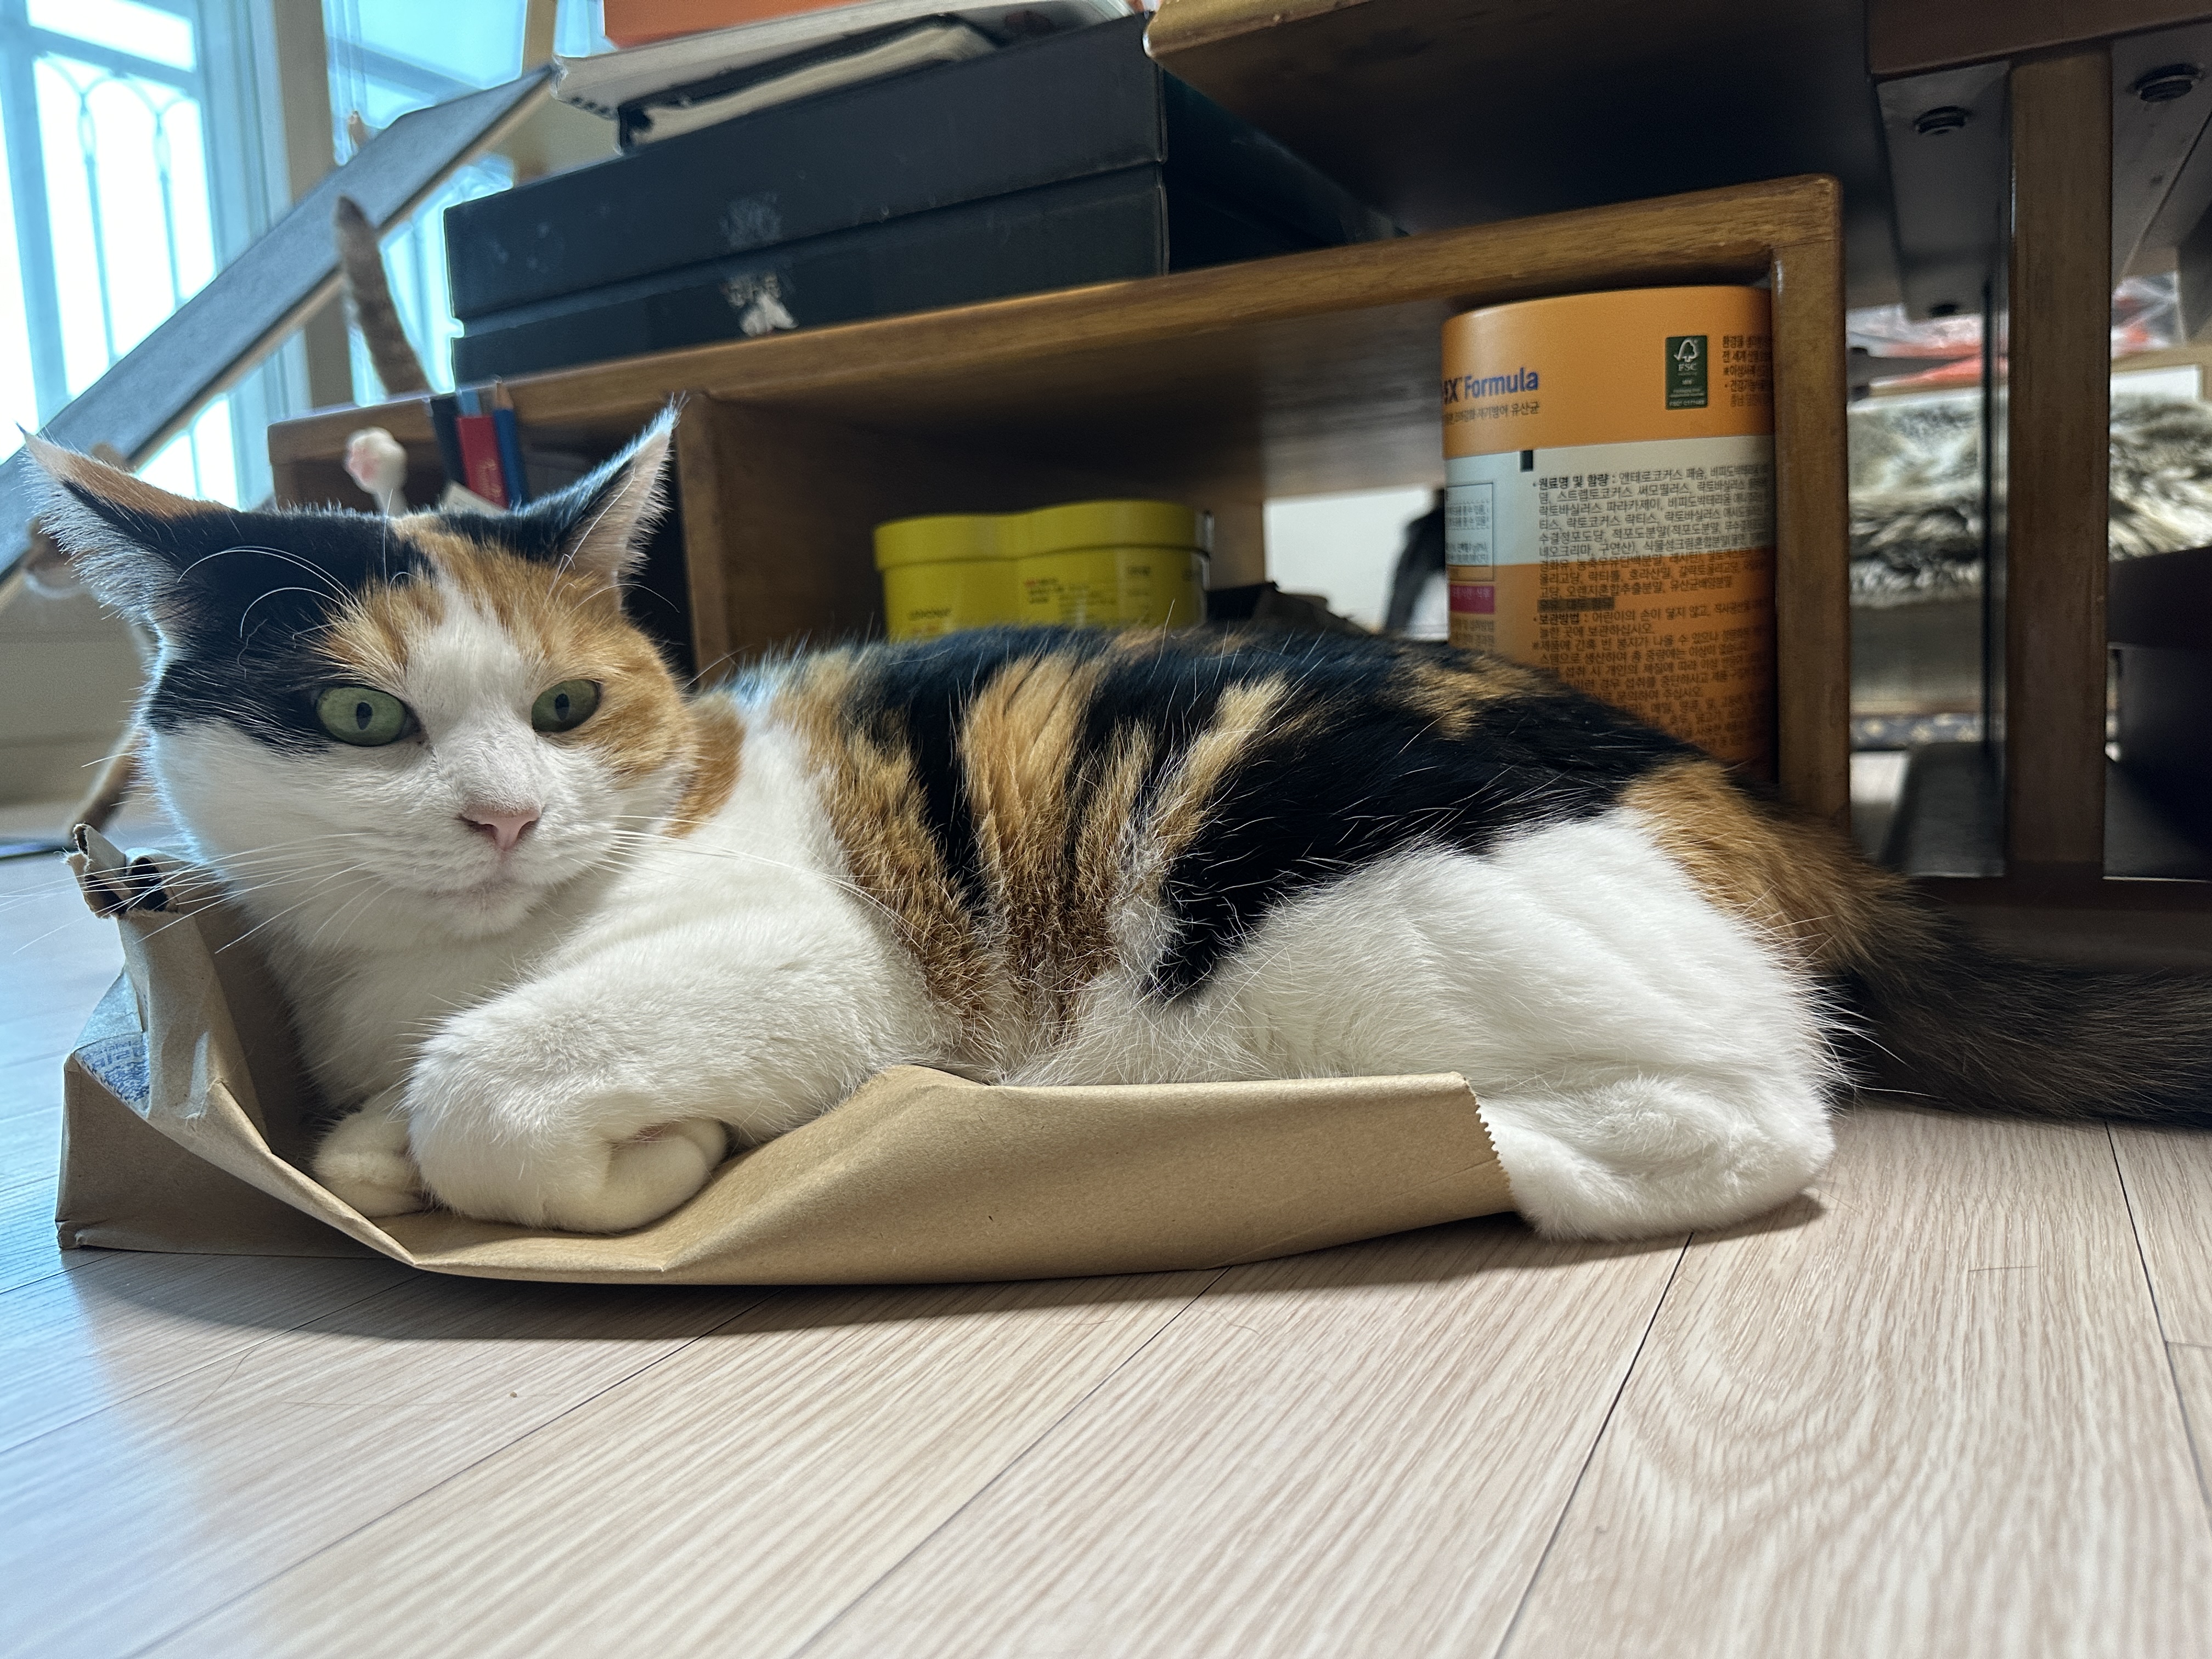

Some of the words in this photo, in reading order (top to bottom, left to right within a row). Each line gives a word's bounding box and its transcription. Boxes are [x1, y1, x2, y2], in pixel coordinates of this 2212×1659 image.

[1464, 367, 1539, 400] Formula
[1510, 400, 1540, 418] 유산균
[1539, 476, 1568, 490] 원료명
[1572, 475, 1583, 488] 및
[1587, 473, 1610, 488] 함량
[1618, 469, 1684, 485] 엔테로코커스
[1557, 487, 1634, 502] 스트렙토코커스
[1697, 478, 1746, 493] 락토바실러스
[1539, 502, 1603, 517] 락토바실러스
[1606, 498, 1664, 513] 파라카제이,
[1668, 493, 1731, 509] 비피도박테리움
[1567, 514, 1622, 531] 락토코커스
[1664, 508, 1721, 524] 락토바실러스
[1539, 612, 1579, 625] 보관방법
[1592, 610, 1636, 624] 어린이의
[1640, 607, 1661, 622] 손이
[1601, 637, 1611, 651] 빈
[1678, 633, 1689, 646] 수
[1566, 665, 1585, 679] 섭취
[1590, 665, 1601, 678] 시
[1605, 662, 1638, 677] 개인의
